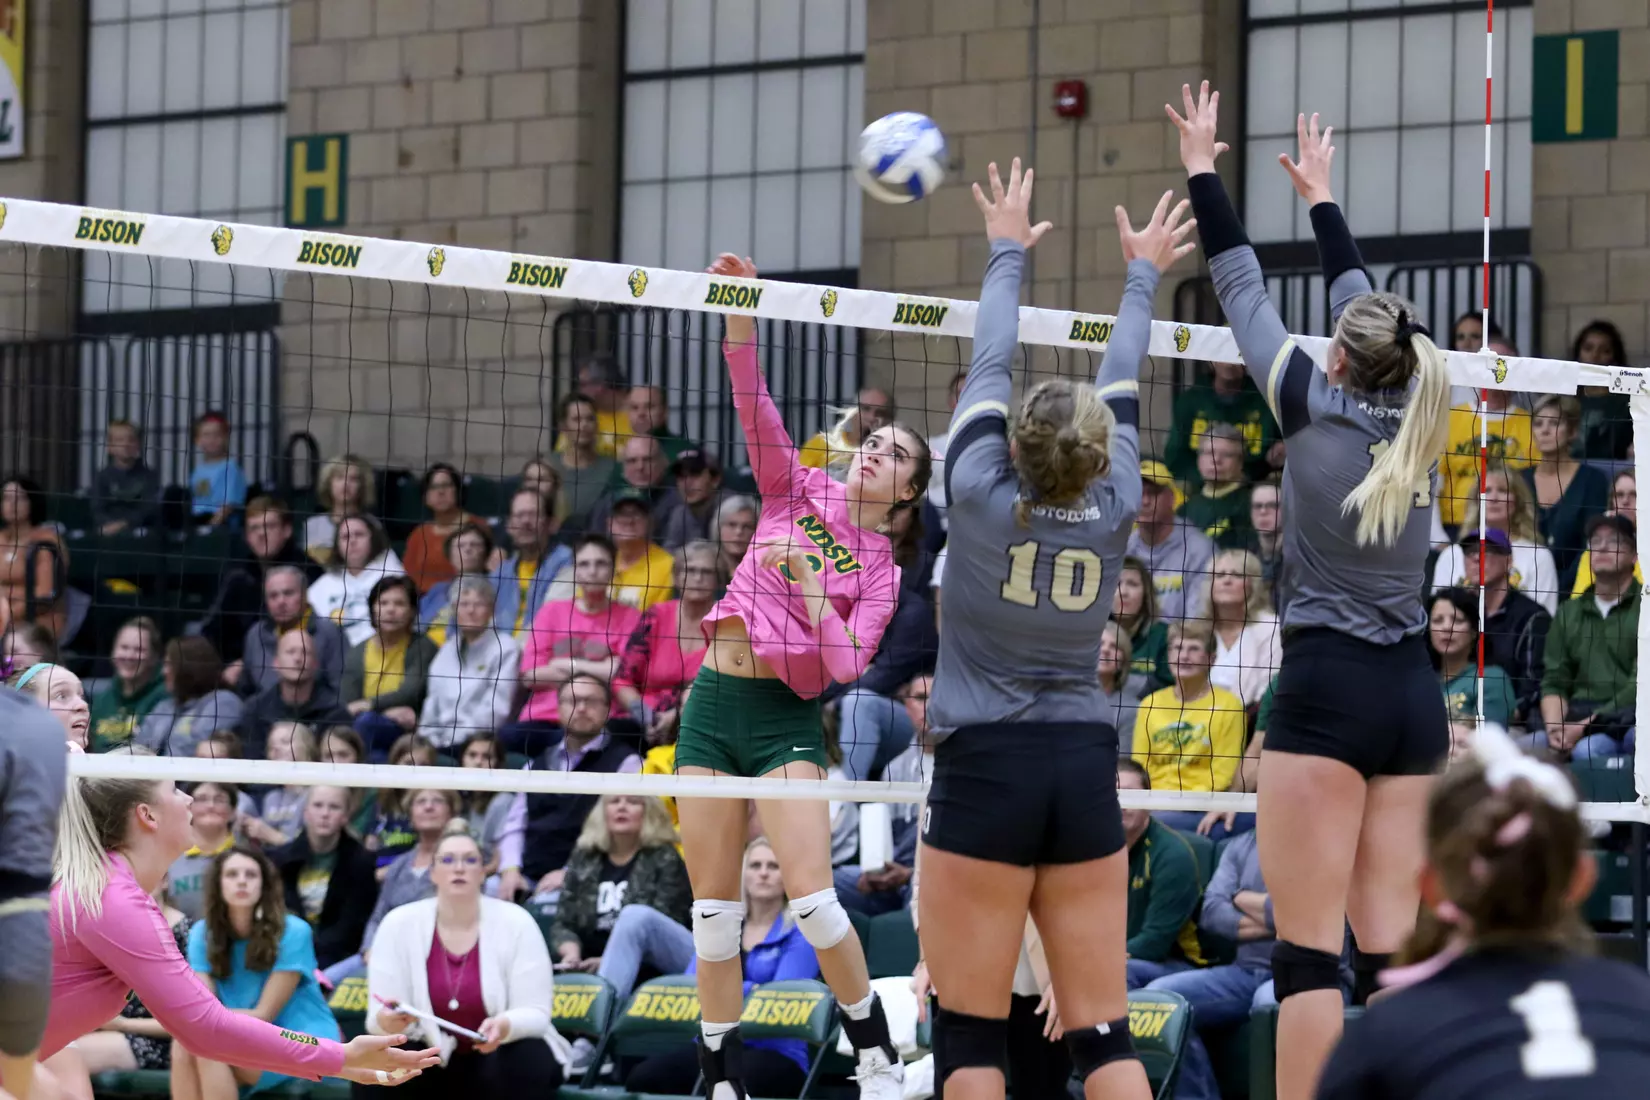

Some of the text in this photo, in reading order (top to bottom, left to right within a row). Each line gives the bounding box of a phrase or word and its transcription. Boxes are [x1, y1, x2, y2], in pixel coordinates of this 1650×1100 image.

[291, 138, 340, 223] H
[75, 216, 145, 245] BISON
[297, 241, 362, 268] BISON
[507, 262, 568, 288] BISON
[704, 282, 763, 309] BISON
[893, 303, 948, 327] BISON
[795, 514, 863, 573] NDSU
[1000, 539, 1104, 612] 10
[627, 992, 701, 1021] BISON
[740, 998, 817, 1025] BISON
[1508, 979, 1597, 1080] 1
